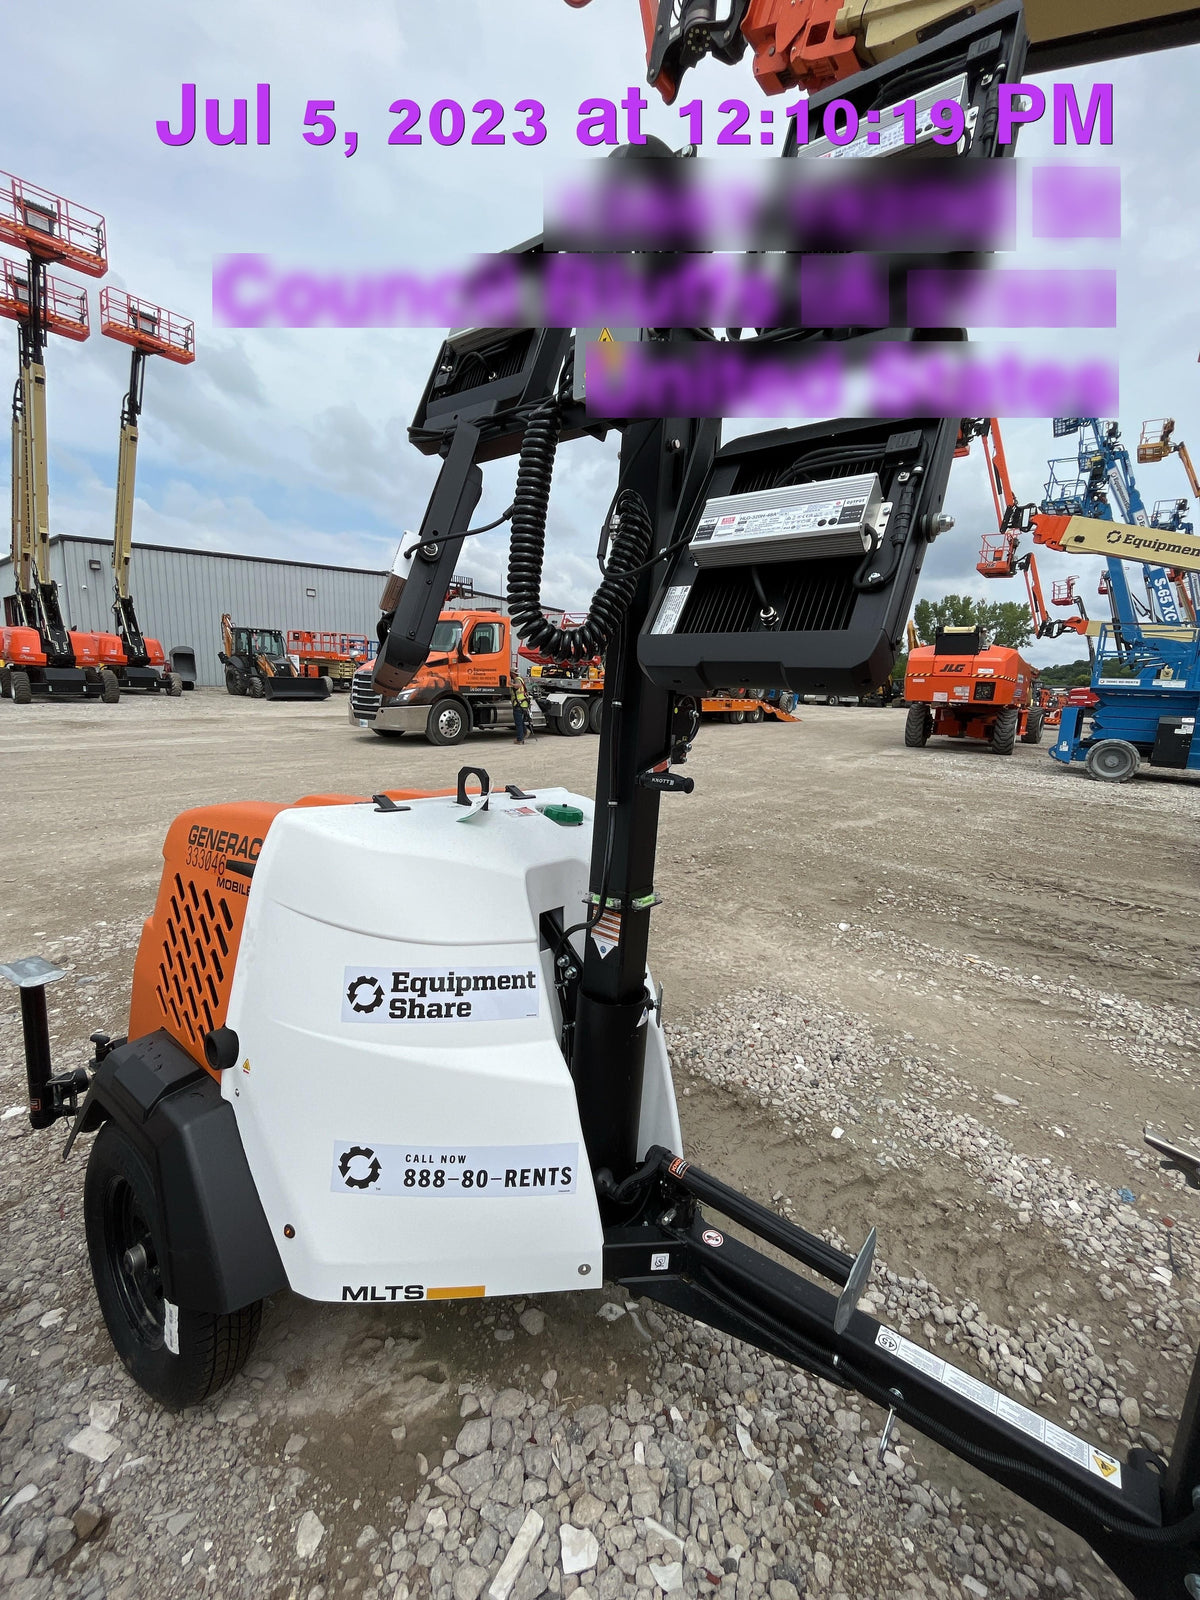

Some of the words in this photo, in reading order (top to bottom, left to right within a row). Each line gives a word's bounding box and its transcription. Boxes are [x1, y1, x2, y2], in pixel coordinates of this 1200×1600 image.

[1154, 578, 1171, 604] S-65
[1163, 606, 1177, 622] XC
[940, 663, 966, 673] JLG
[188, 824, 264, 861] GENERAC
[186, 845, 226, 876] 333046
[391, 971, 536, 997] Equipment
[388, 998, 472, 1019] Share
[405, 1154, 435, 1164] CALL
[440, 1154, 467, 1164] NOW
[341, 1284, 424, 1301] MLTS
